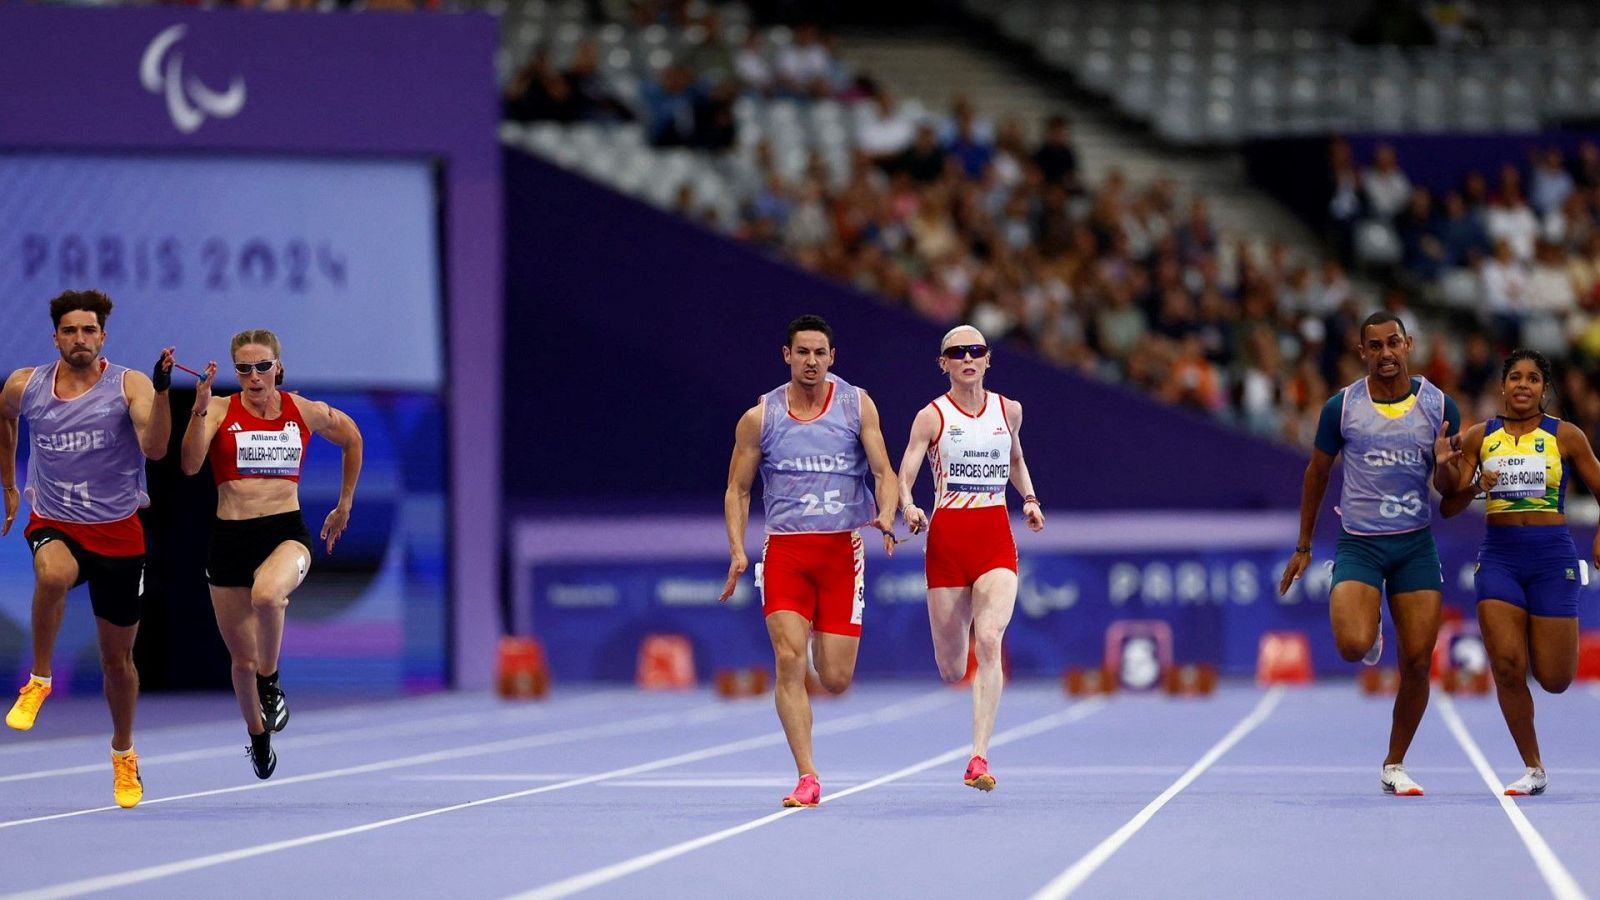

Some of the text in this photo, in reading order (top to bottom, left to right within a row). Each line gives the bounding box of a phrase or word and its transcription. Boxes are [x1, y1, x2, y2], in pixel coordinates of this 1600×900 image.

[22, 233, 348, 295] PARIS 2024
[36, 429, 105, 452] GUIDE
[963, 450, 989, 458] Allianz
[949, 463, 982, 478] BERGES
[1509, 472, 1518, 486] de
[1518, 471, 1545, 486] AGUIAR
[54, 480, 92, 508] 71
[800, 489, 846, 517] 25
[1108, 560, 1260, 606] PARIS
